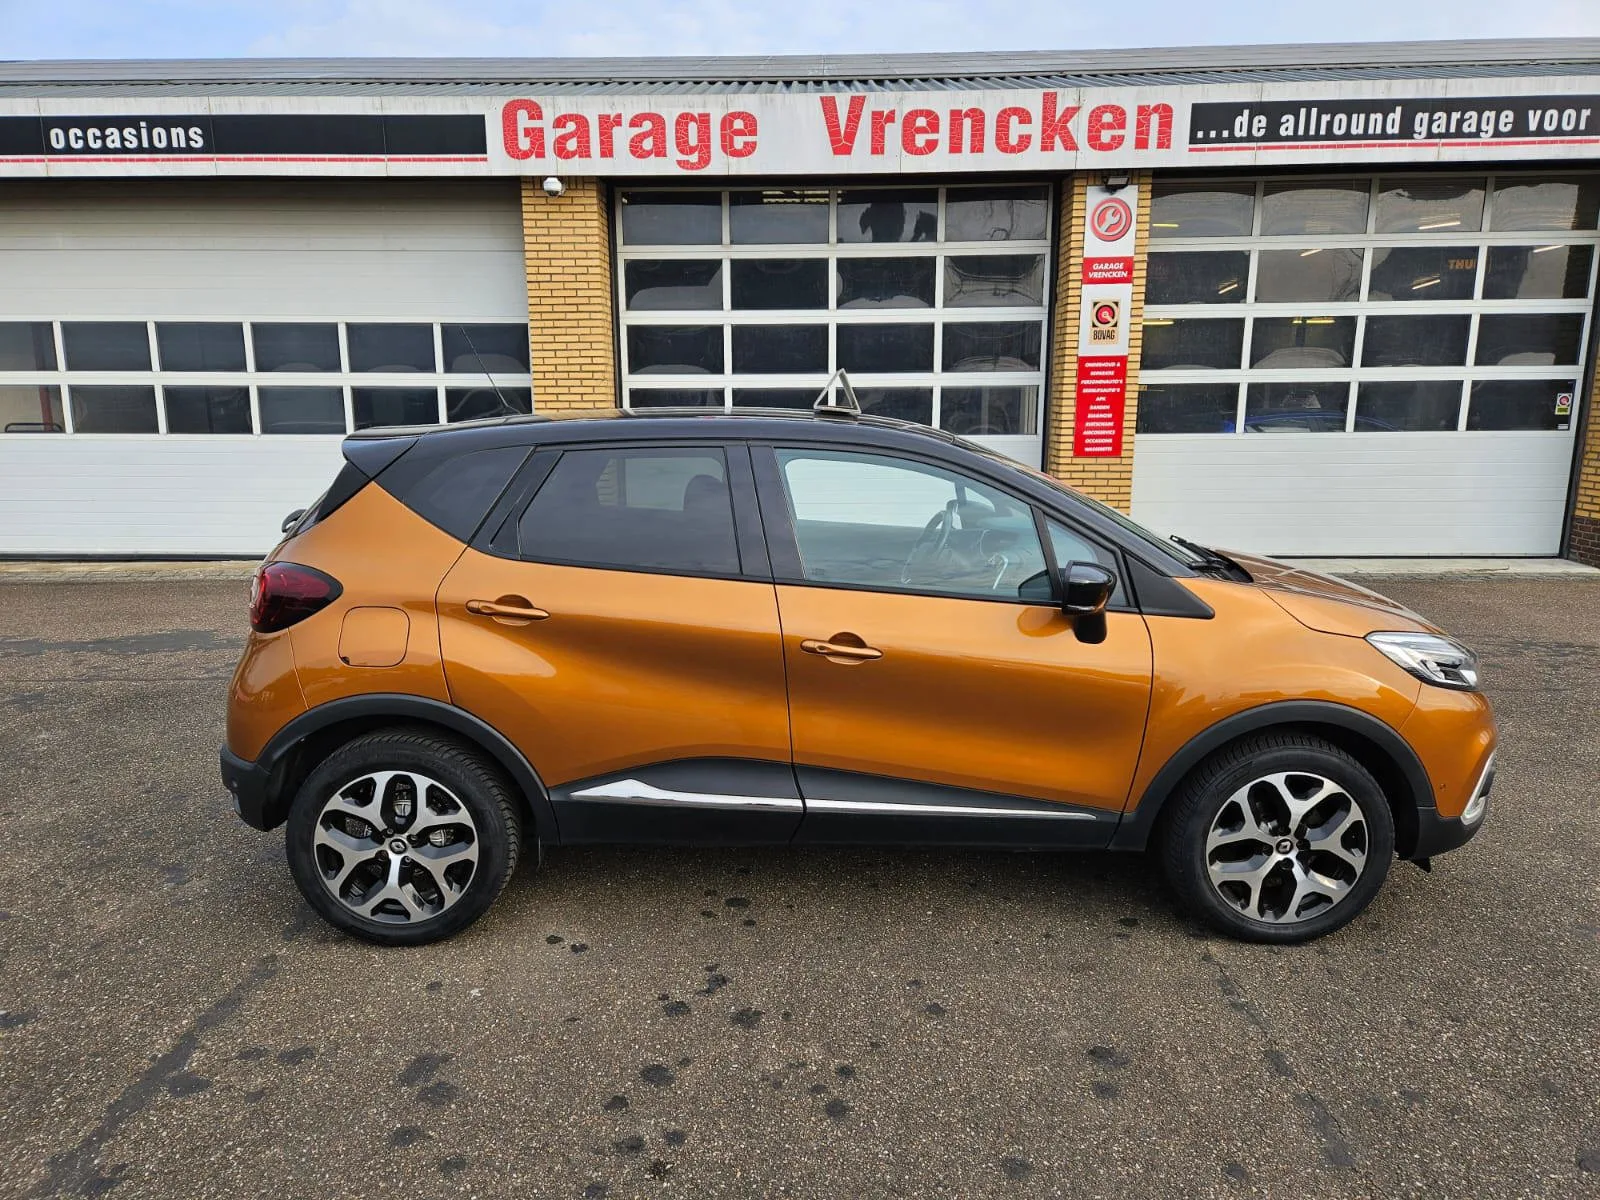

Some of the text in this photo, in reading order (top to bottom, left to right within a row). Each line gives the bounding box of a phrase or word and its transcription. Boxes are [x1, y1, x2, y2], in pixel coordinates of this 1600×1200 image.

[49, 121, 205, 150] occasions
[502, 92, 1174, 170] Garage Vrencken
[1279, 105, 1402, 138] allround
[1413, 109, 1515, 139] garage
[1528, 108, 1592, 133] voor
[1088, 271, 1128, 279] VRENCKEN
[1093, 329, 1115, 340] BOVAG
